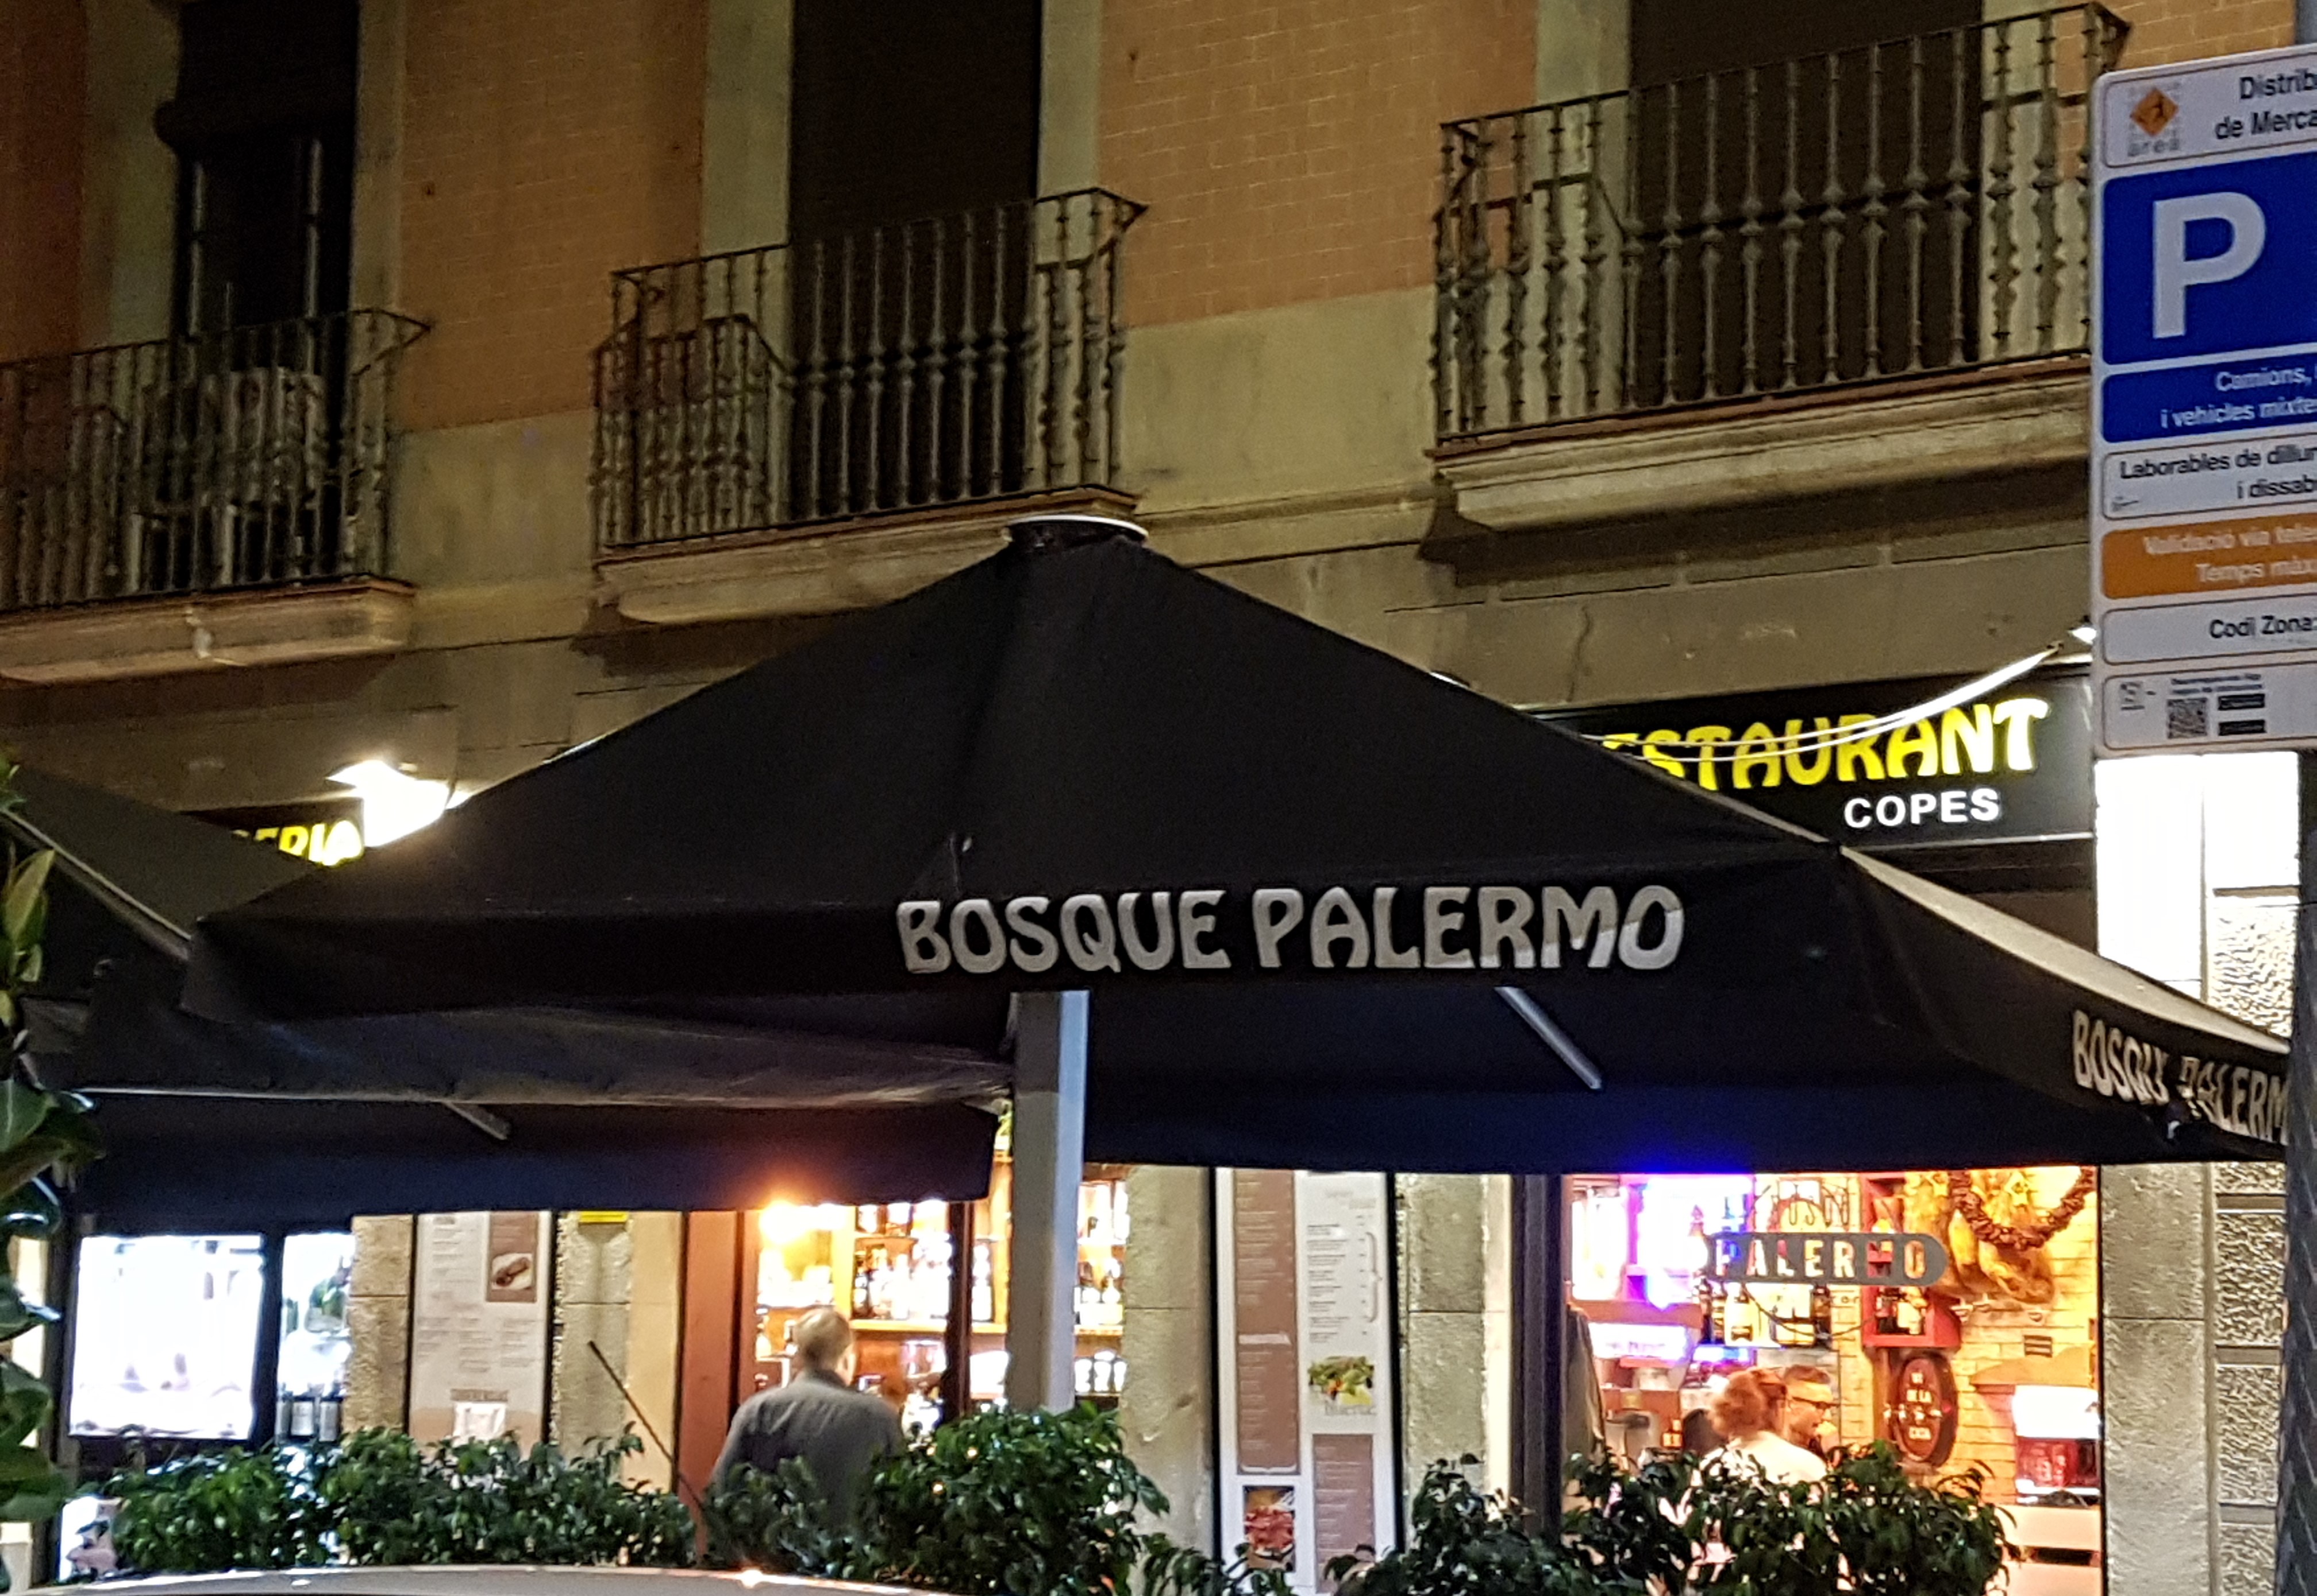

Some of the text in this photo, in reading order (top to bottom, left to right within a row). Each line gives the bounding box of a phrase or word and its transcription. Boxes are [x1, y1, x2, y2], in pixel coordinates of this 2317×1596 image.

[2215, 117, 2243, 139] de
[2153, 192, 2266, 339] P
[2172, 403, 2256, 426] vehicles
[2120, 453, 2230, 479] Laborables
[2235, 449, 2262, 468] de
[2237, 480, 2243, 499] i
[2195, 563, 2265, 583] Temps
[2210, 616, 2256, 638] Codi
[1603, 698, 2049, 791] STAURANT
[1844, 788, 2000, 828] COPES
[896, 885, 1685, 974] BOSQUE PALERMO
[1716, 1239, 1926, 1279] PALERMO
